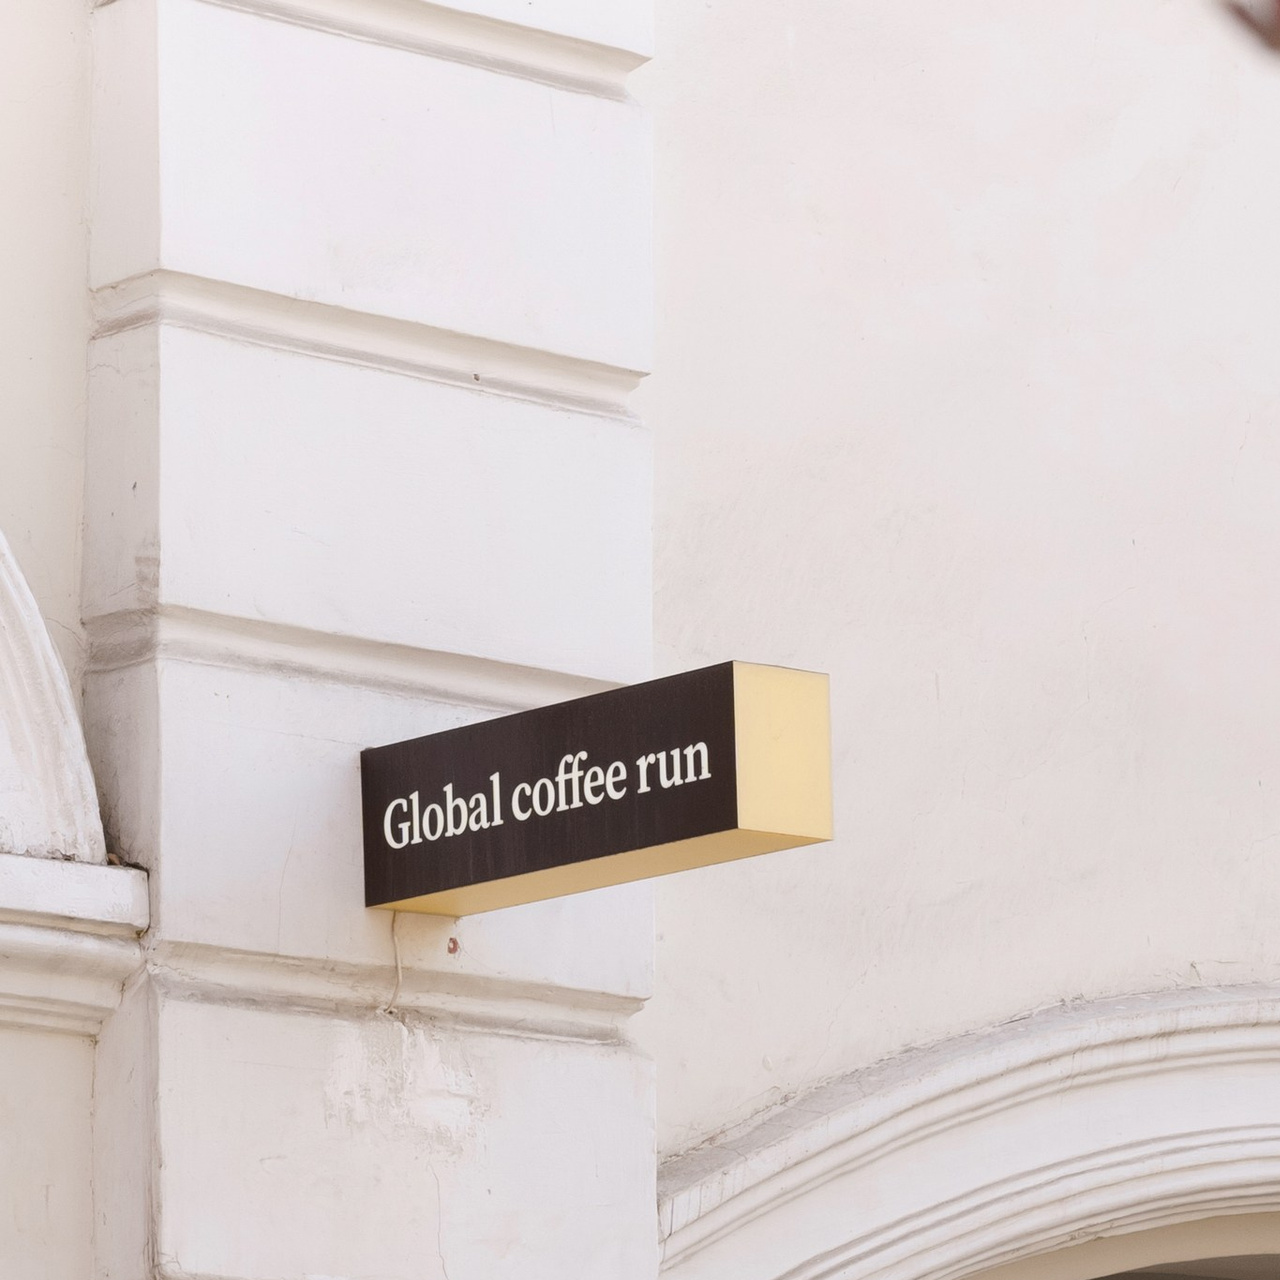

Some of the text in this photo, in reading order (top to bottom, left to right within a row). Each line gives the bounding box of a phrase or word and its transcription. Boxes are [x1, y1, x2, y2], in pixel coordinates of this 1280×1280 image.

[383, 741, 712, 849] Global coffee run
